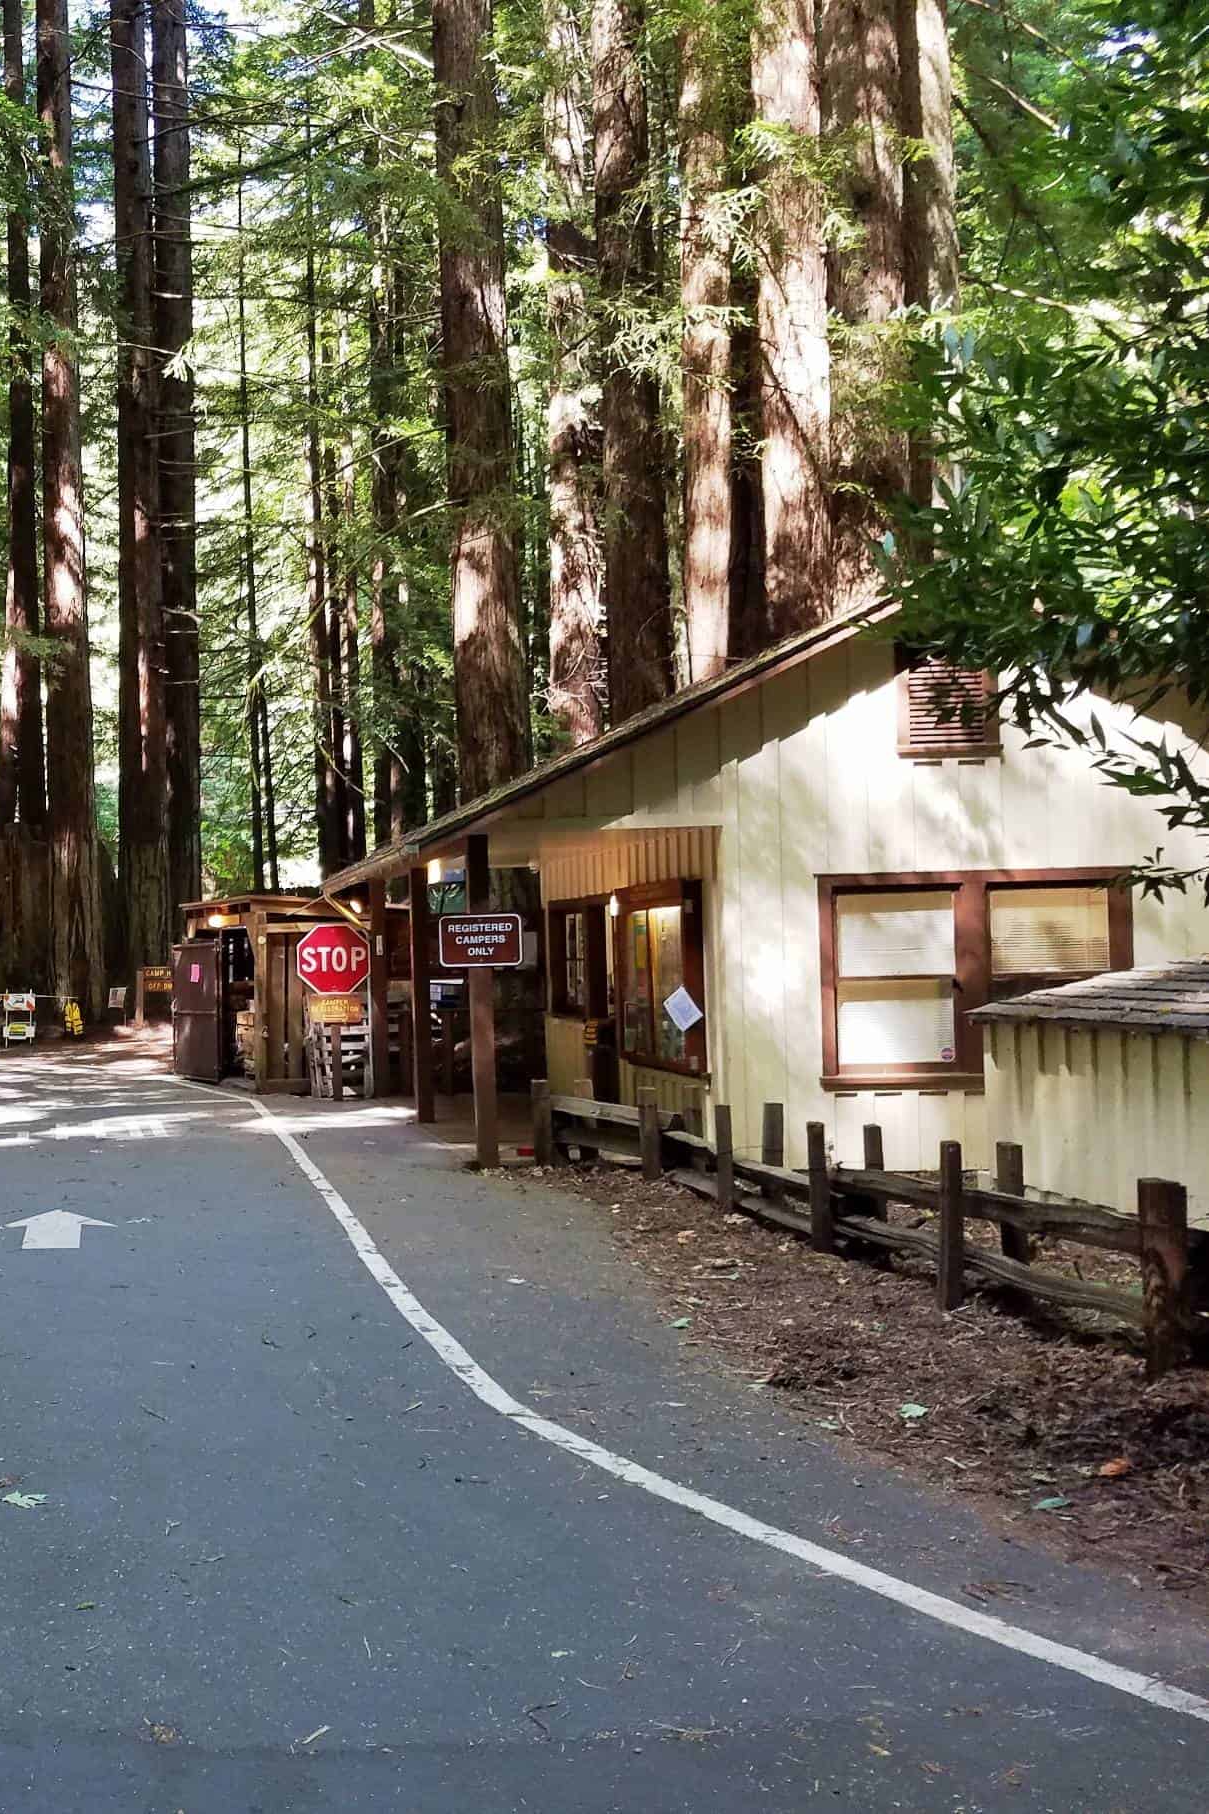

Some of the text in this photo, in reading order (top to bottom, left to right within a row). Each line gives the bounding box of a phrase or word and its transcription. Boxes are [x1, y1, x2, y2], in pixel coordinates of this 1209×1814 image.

[447, 923, 512, 933] REGISTERED
[455, 935, 506, 945] CAMPERS
[467, 947, 494, 956] ONLY
[301, 946, 367, 973] STOP
